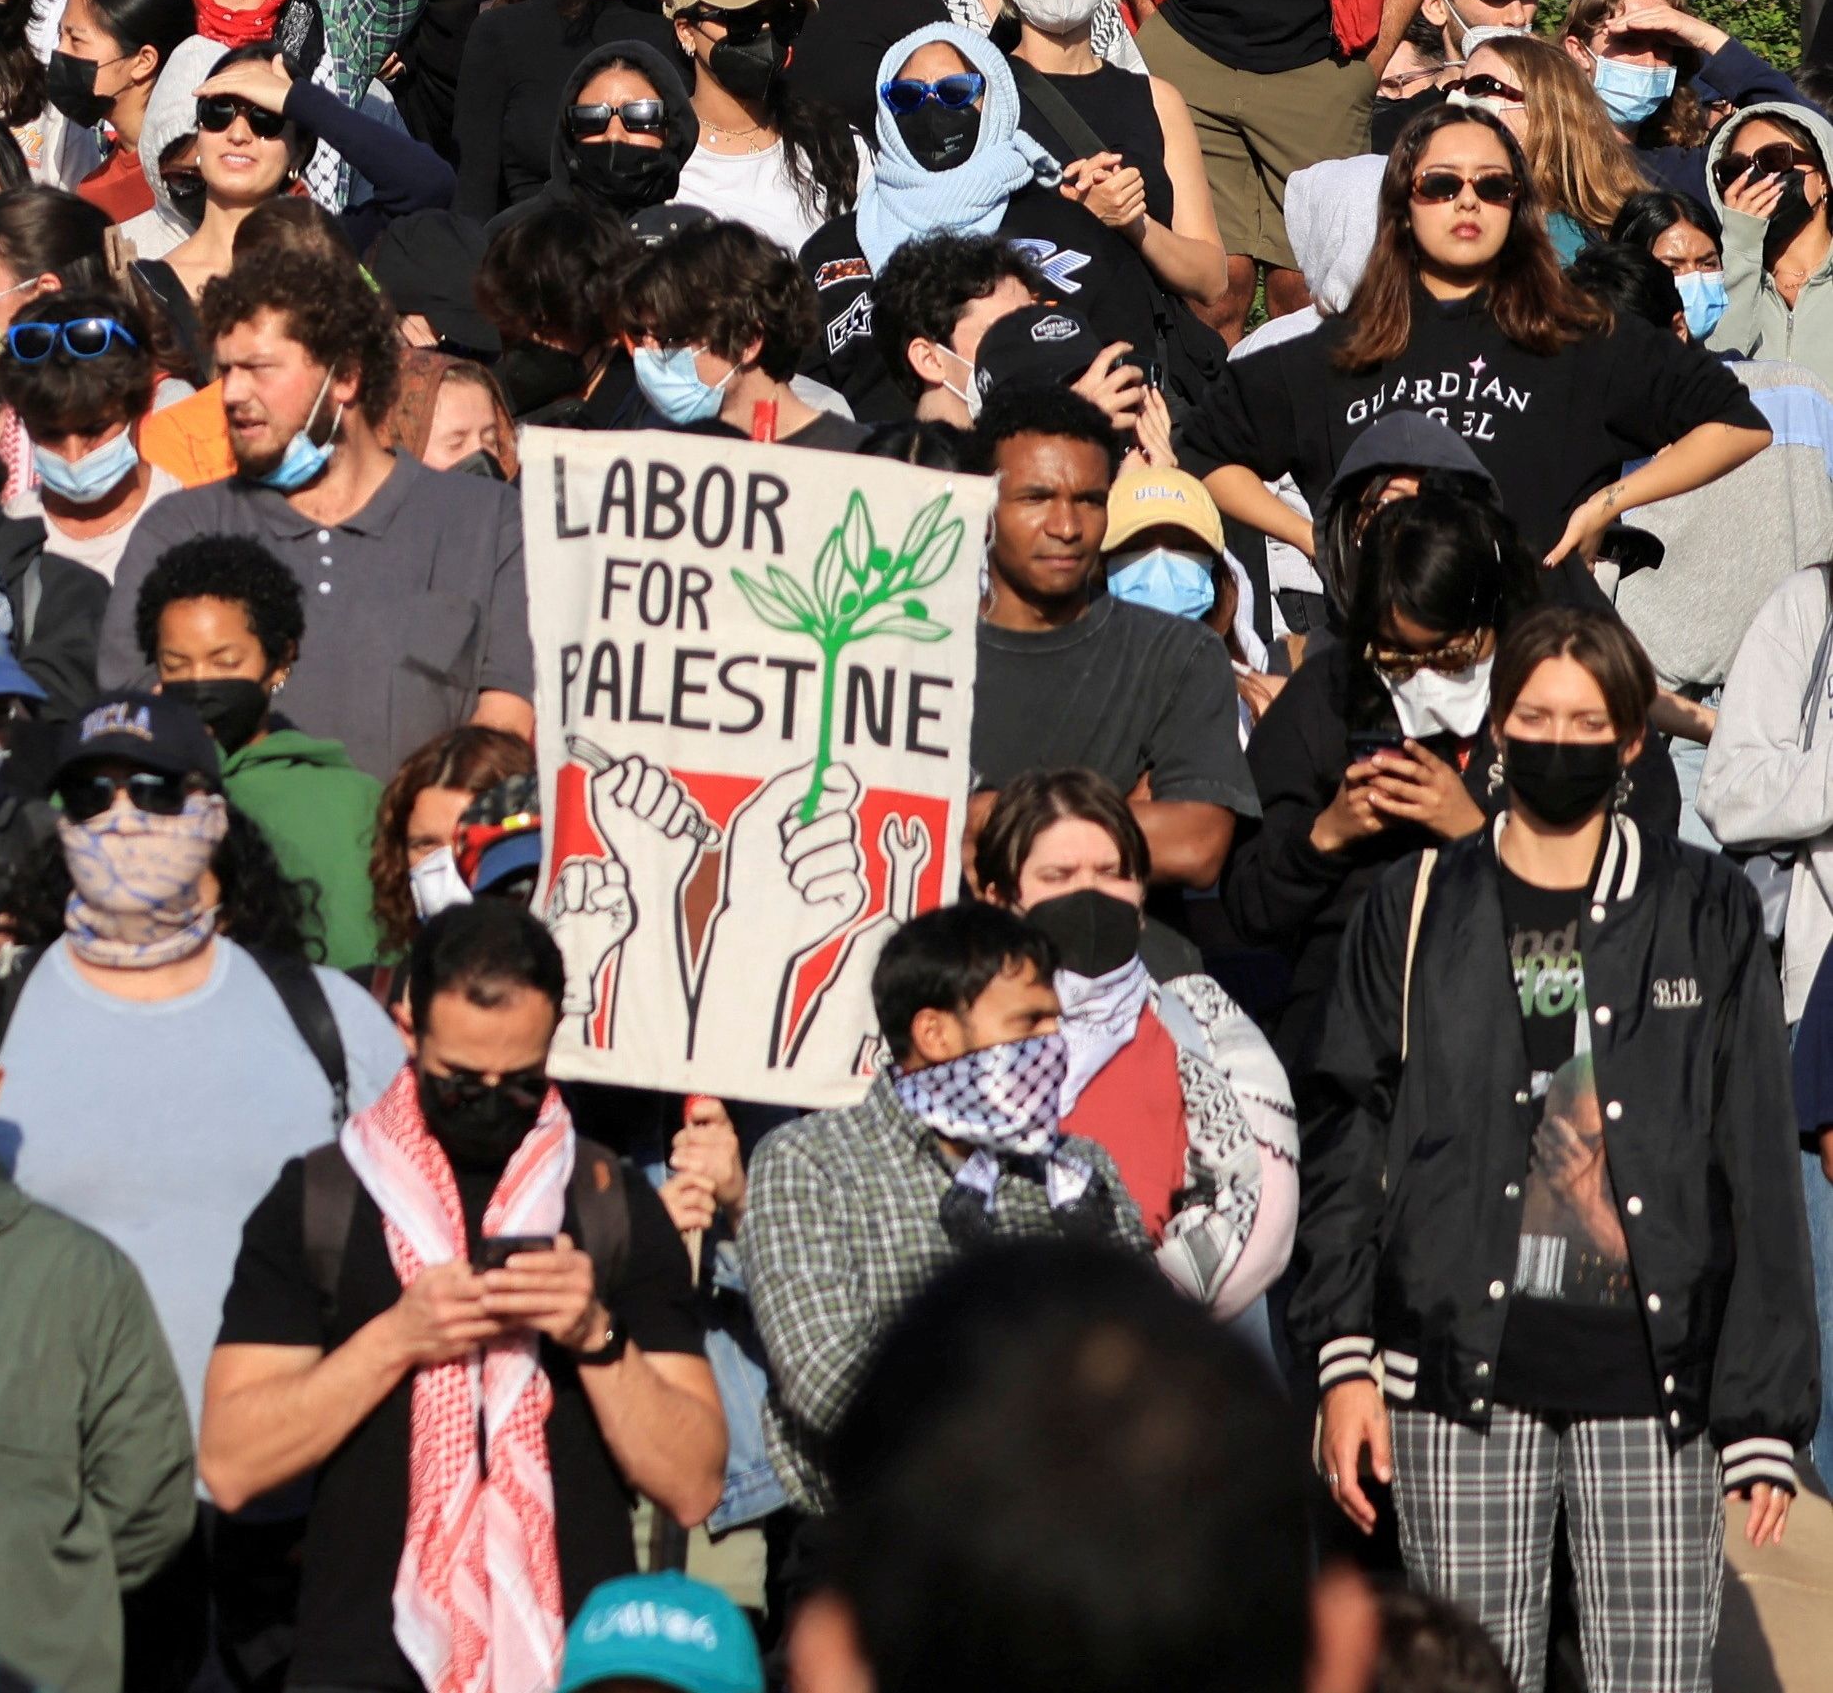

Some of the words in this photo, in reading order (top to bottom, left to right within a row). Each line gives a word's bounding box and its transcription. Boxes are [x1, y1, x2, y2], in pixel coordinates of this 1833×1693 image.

[1345, 372, 1532, 426] GUARDIAN
[1413, 407, 1495, 442] GEL
[553, 454, 789, 555] LABOR
[1135, 485, 1185, 503] UCLA
[600, 557, 713, 631] FOR
[1653, 977, 1702, 1009] Bill
